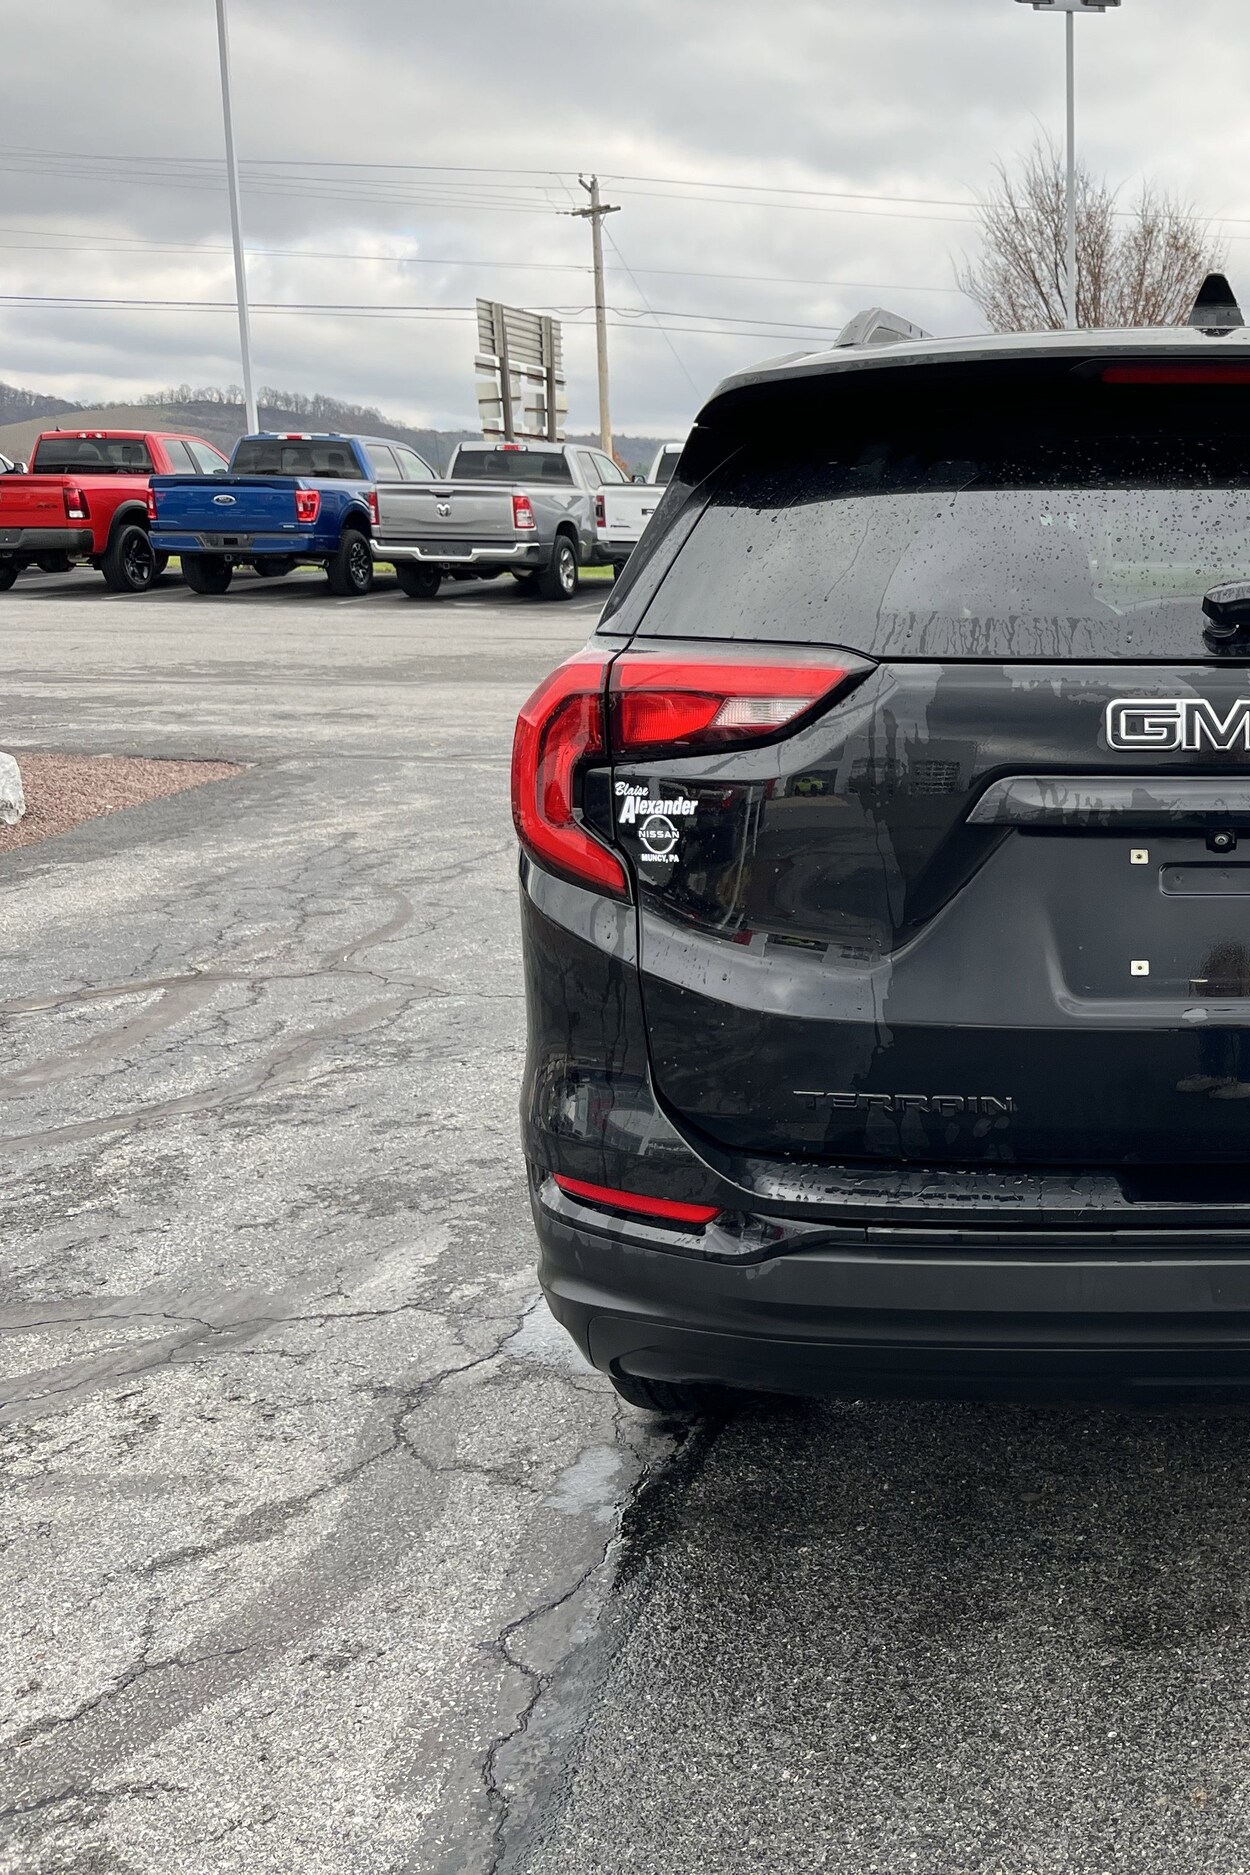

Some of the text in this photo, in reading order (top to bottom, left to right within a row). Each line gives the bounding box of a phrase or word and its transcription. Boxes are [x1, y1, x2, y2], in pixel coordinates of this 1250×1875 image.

[615, 781, 649, 796] Blaise
[619, 796, 698, 824] Alexander
[638, 830, 680, 839] NISSAN
[641, 854, 680, 863] MUNCY, PA
[793, 1091, 1018, 1112] TERRAIN
